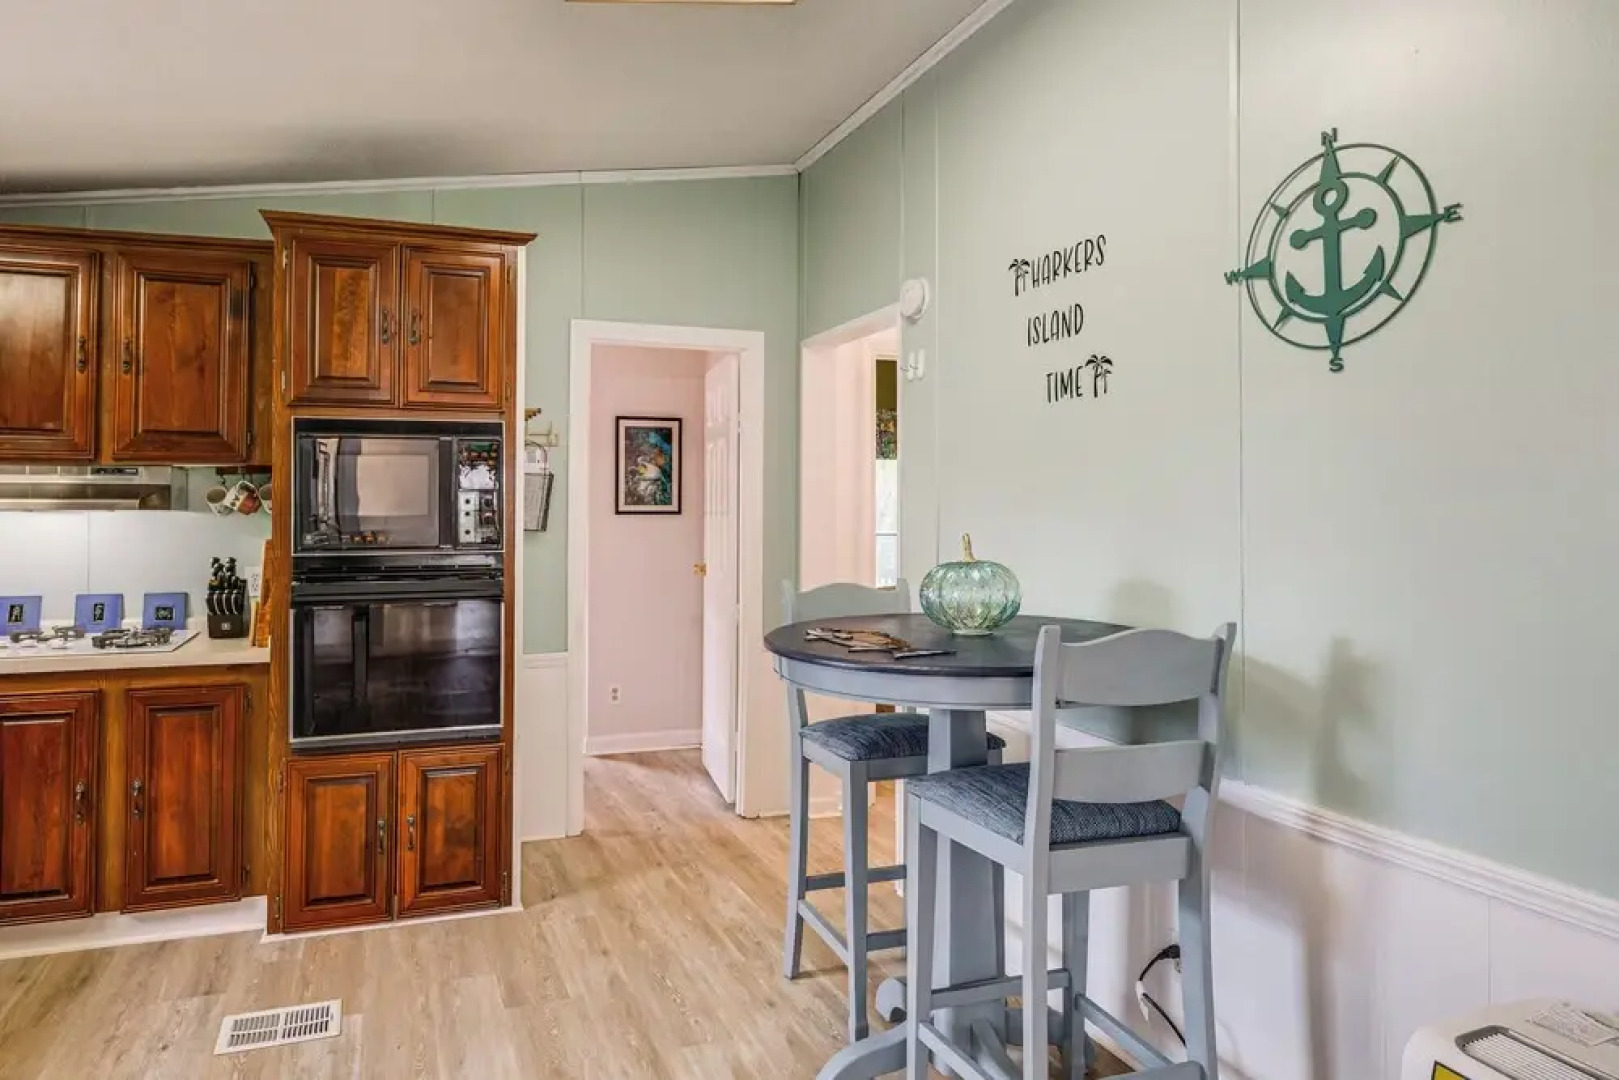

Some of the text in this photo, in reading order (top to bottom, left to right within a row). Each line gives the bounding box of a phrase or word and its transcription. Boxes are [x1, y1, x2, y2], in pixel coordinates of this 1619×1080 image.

[1321, 127, 1338, 145] N
[1443, 202, 1464, 223] E
[1031, 234, 1107, 288] HARKERS
[1027, 303, 1084, 347] ISLAND
[1329, 357, 1344, 373] S
[1046, 365, 1084, 404] TIME
